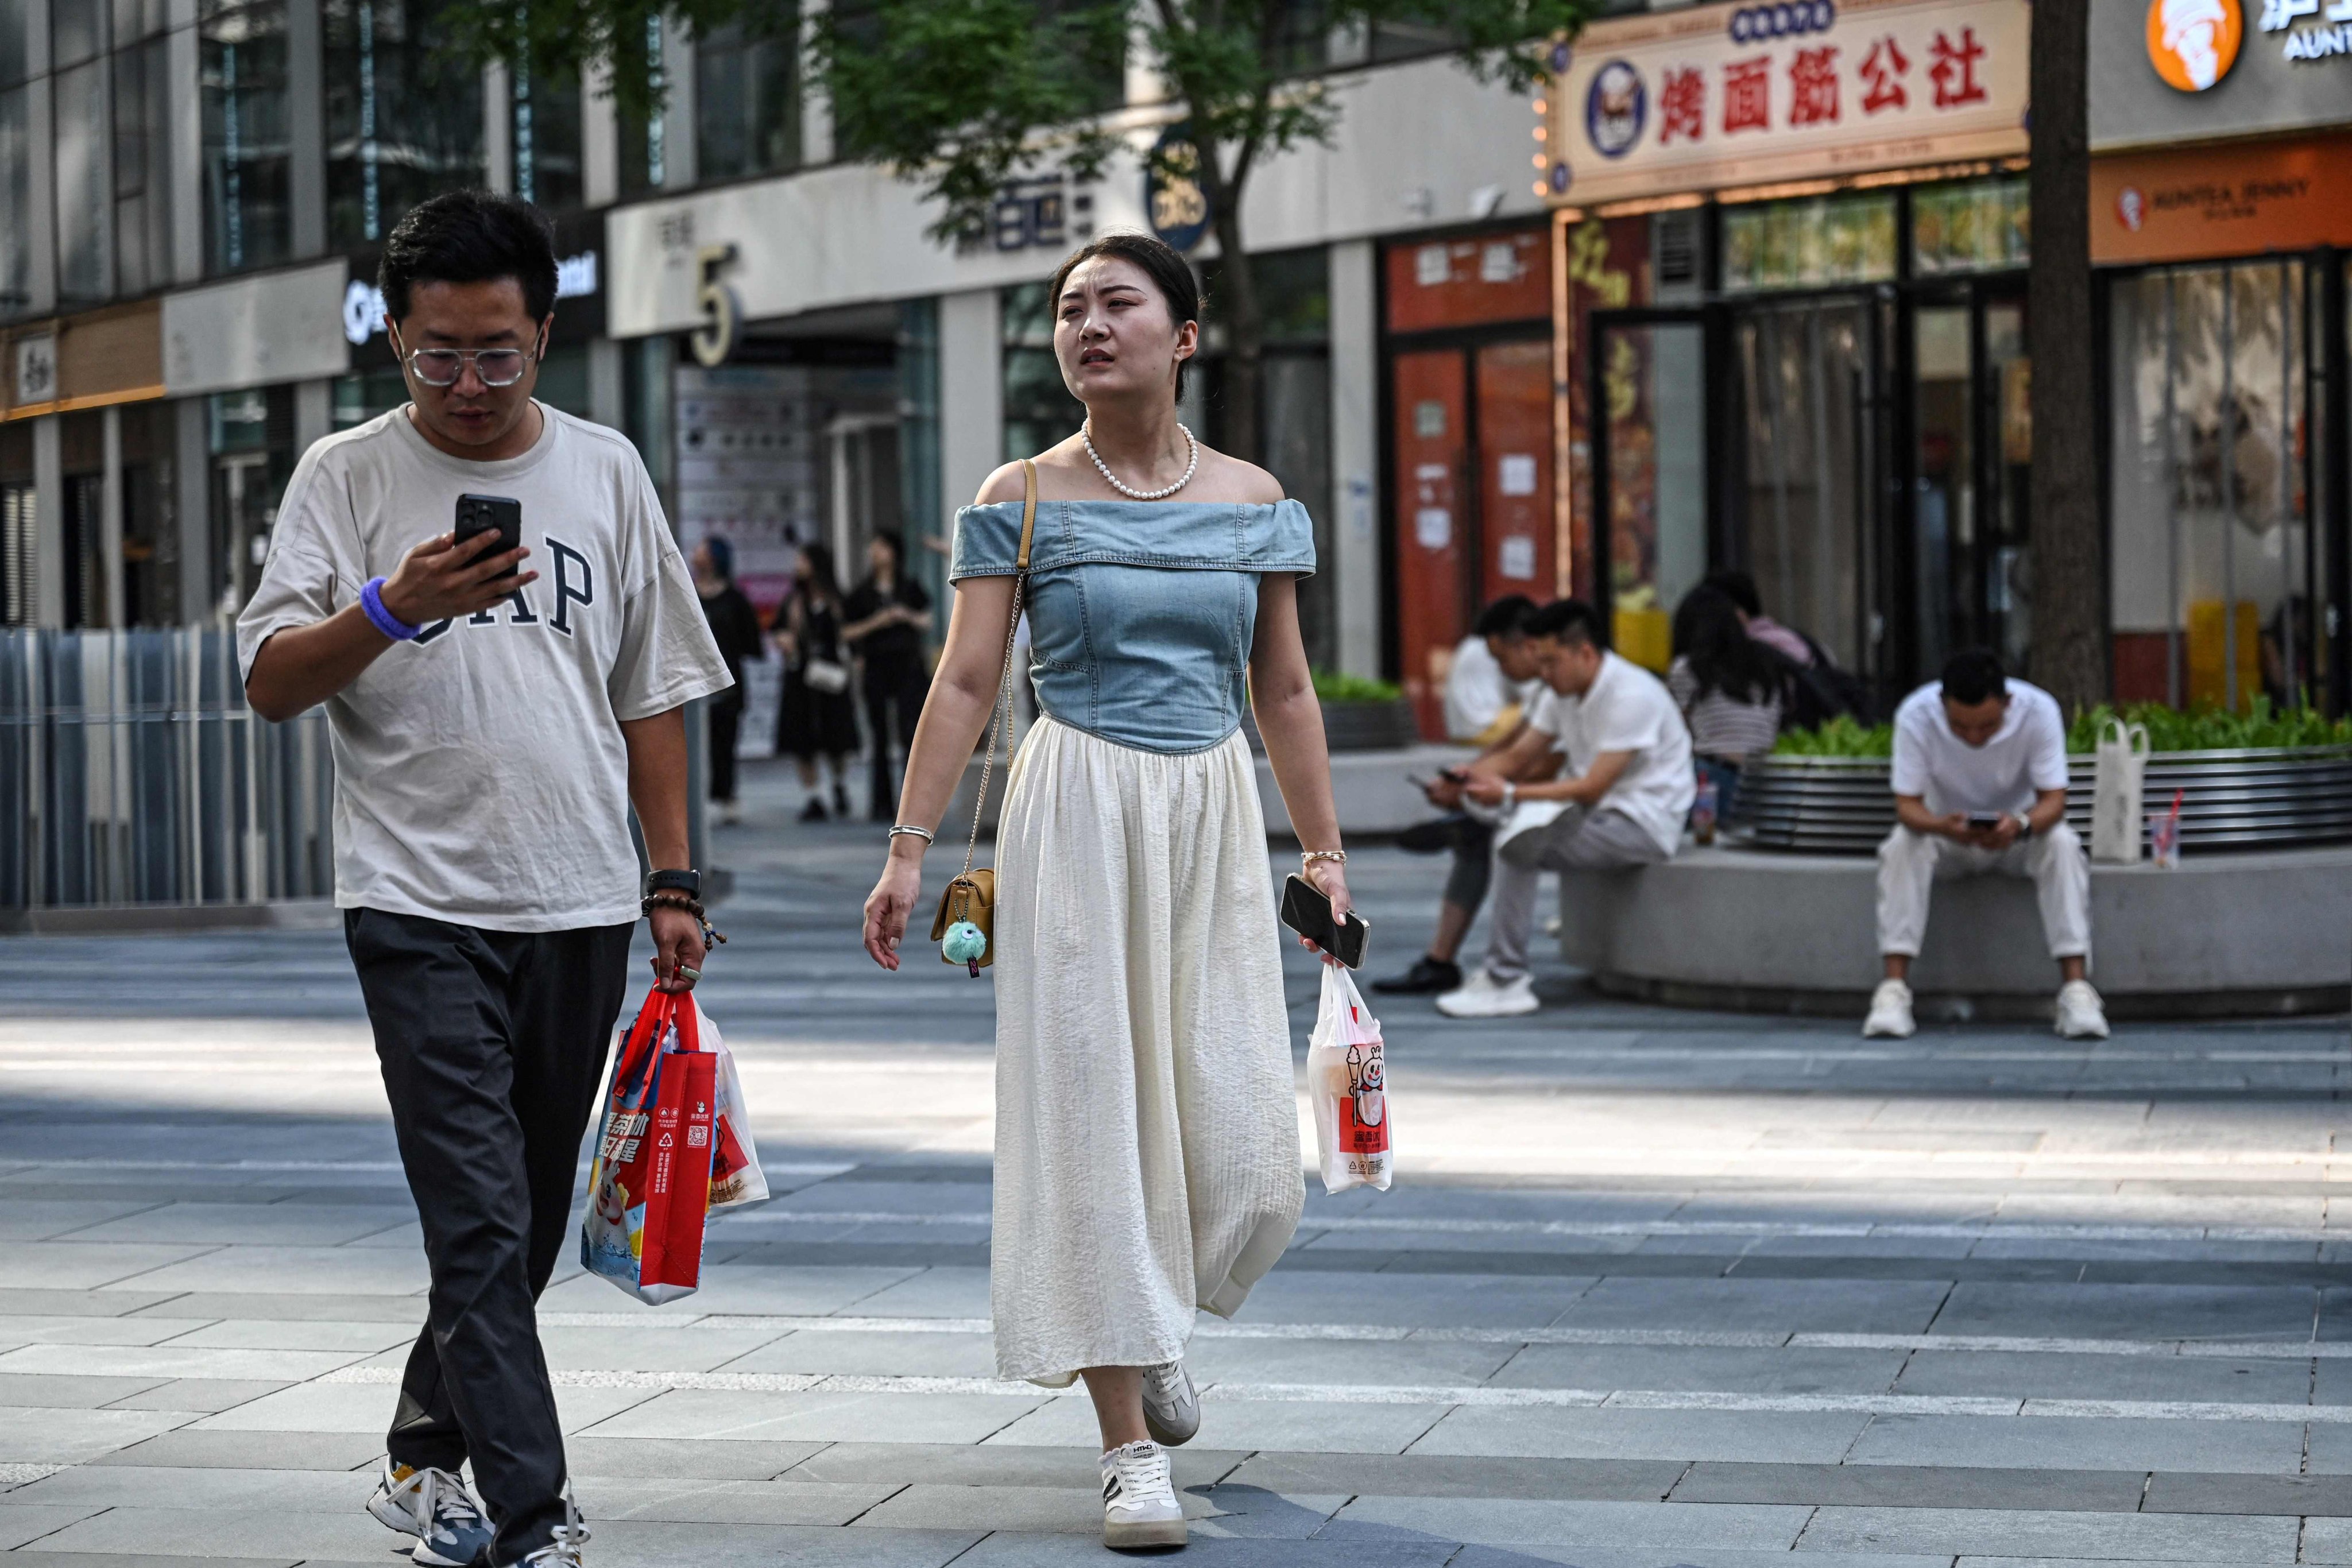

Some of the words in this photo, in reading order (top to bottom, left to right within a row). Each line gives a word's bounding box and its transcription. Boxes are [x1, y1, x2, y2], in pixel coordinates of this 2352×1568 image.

[1658, 26, 1987, 144] 烤面筋公社
[691, 242, 739, 367] 5
